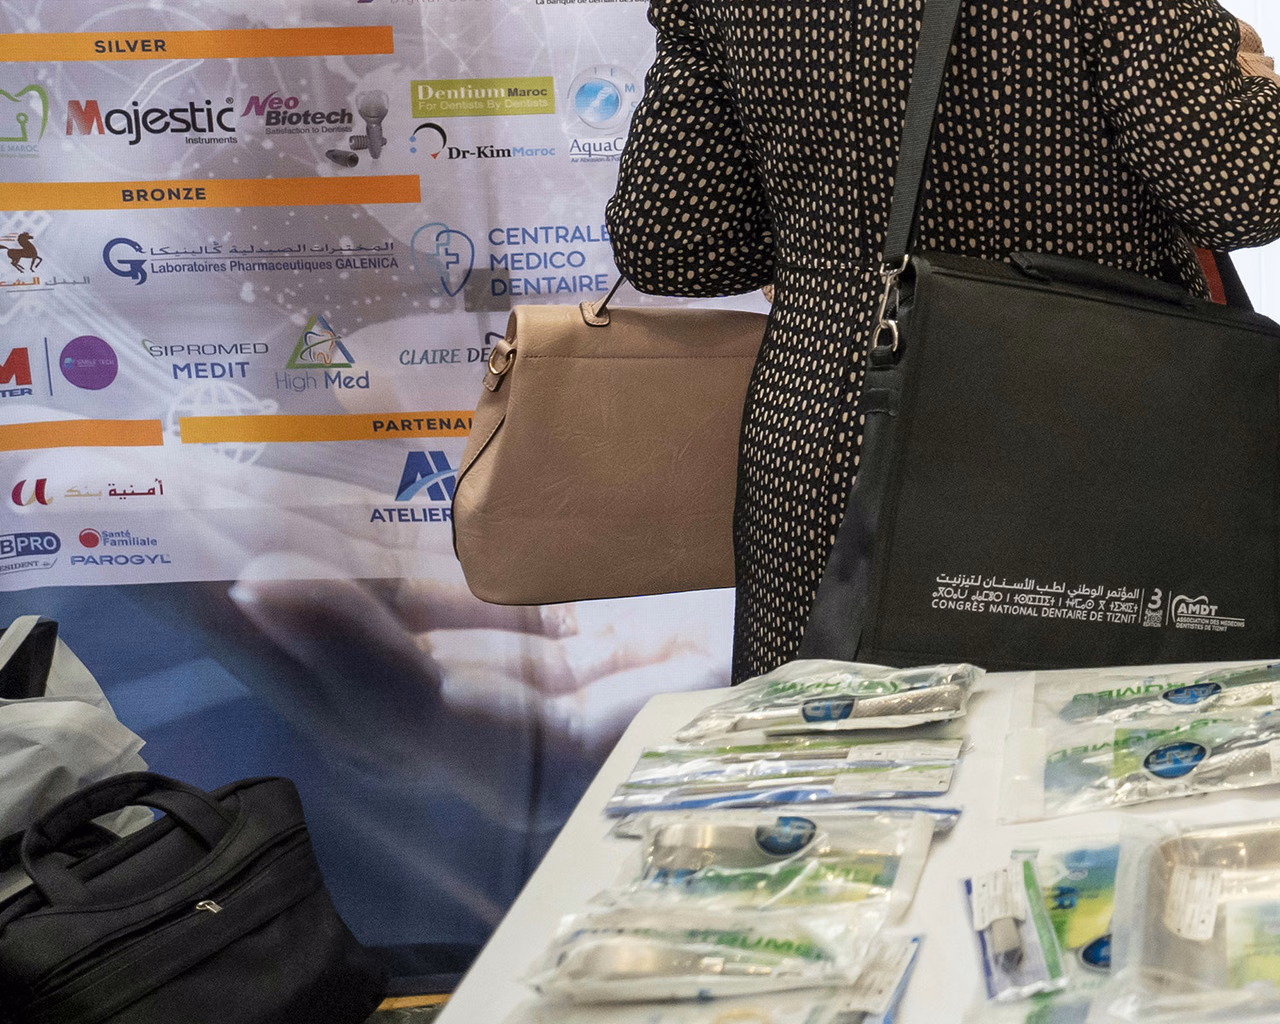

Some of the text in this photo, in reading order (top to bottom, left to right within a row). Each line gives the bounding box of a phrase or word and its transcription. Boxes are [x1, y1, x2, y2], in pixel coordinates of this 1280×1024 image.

[94, 39, 167, 54] SILVER
[417, 84, 548, 101] Dentium Maroc
[240, 90, 299, 118] Neo
[418, 98, 548, 112] For Dentists By Dentists
[265, 109, 353, 126] Biotech
[265, 127, 311, 136] Satisfaction
[321, 126, 353, 134] Dentists
[185, 136, 238, 145] Instruments
[121, 187, 207, 204] BRONZE
[488, 226, 611, 246] CENTRALE
[151, 258, 399, 275] Laboratoires Pharmaceutiques GALENICA
[491, 250, 586, 272] MEDICO
[491, 274, 609, 297] DENTAIRE
[149, 343, 269, 357] SIPROMED
[400, 349, 461, 366] CLAIRE
[172, 361, 250, 380] MEDIT
[275, 371, 370, 392] High Med
[102, 529, 130, 538] Santé
[103, 536, 157, 546] Familiale
[70, 554, 171, 566] PAROGYL
[1148, 587, 1163, 610] 3
[931, 599, 985, 612] CONGRÈS
[989, 604, 1038, 617] NATIONAL
[1041, 608, 1087, 621] DENTAIRE
[1089, 612, 1103, 621] DE
[1106, 612, 1137, 624] TIZNIT
[1177, 602, 1218, 616] AMDT
